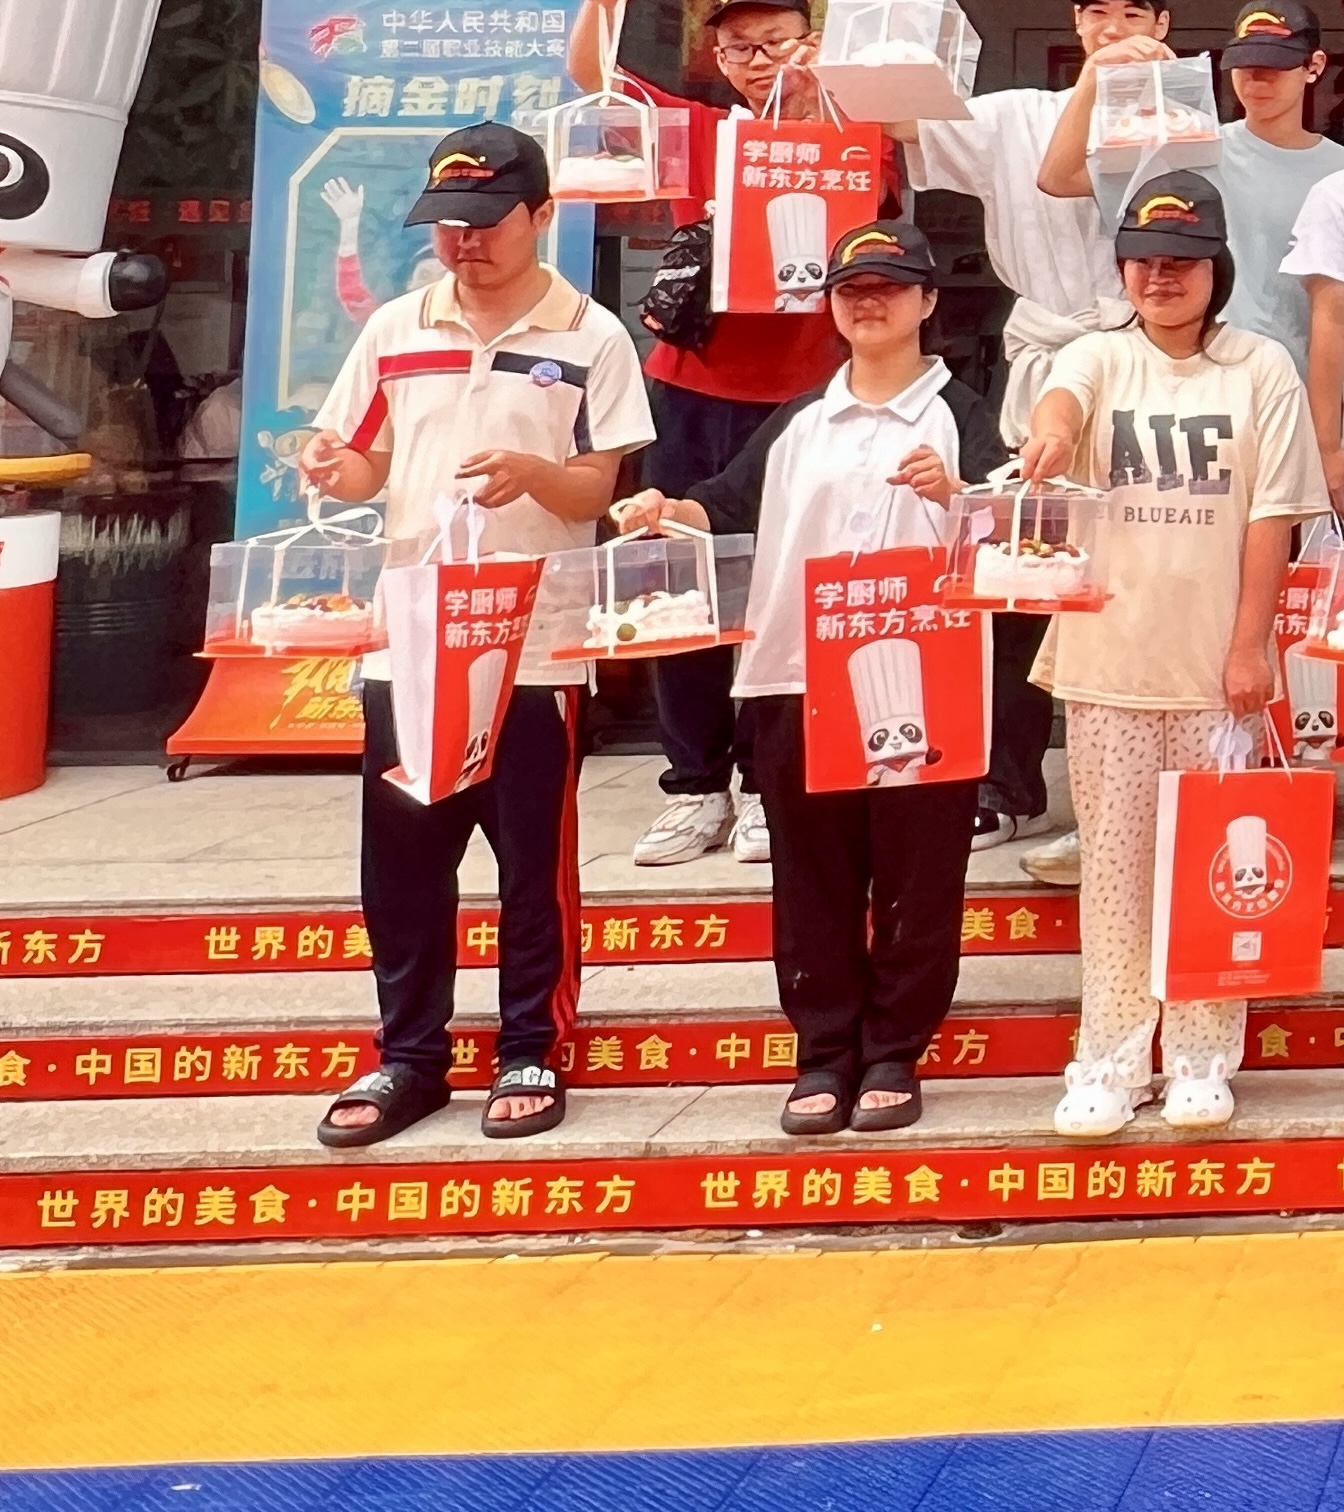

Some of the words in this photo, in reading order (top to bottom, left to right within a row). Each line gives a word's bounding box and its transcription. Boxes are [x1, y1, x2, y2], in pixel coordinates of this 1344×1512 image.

[381, 9, 567, 35] 中华人民共和国
[742, 140, 821, 165] 学厨师
[742, 165, 872, 192] 新东方烹饪
[1109, 409, 1233, 495] AIE
[1124, 506, 1215, 525] BLUEAIE
[443, 587, 519, 617] 学厨师
[814, 576, 908, 610] 学厨师
[701, 1157, 1276, 1211] 世界的美食·中国的新东方
[38, 1175, 637, 1229] 世界的美食·中国的新东方
